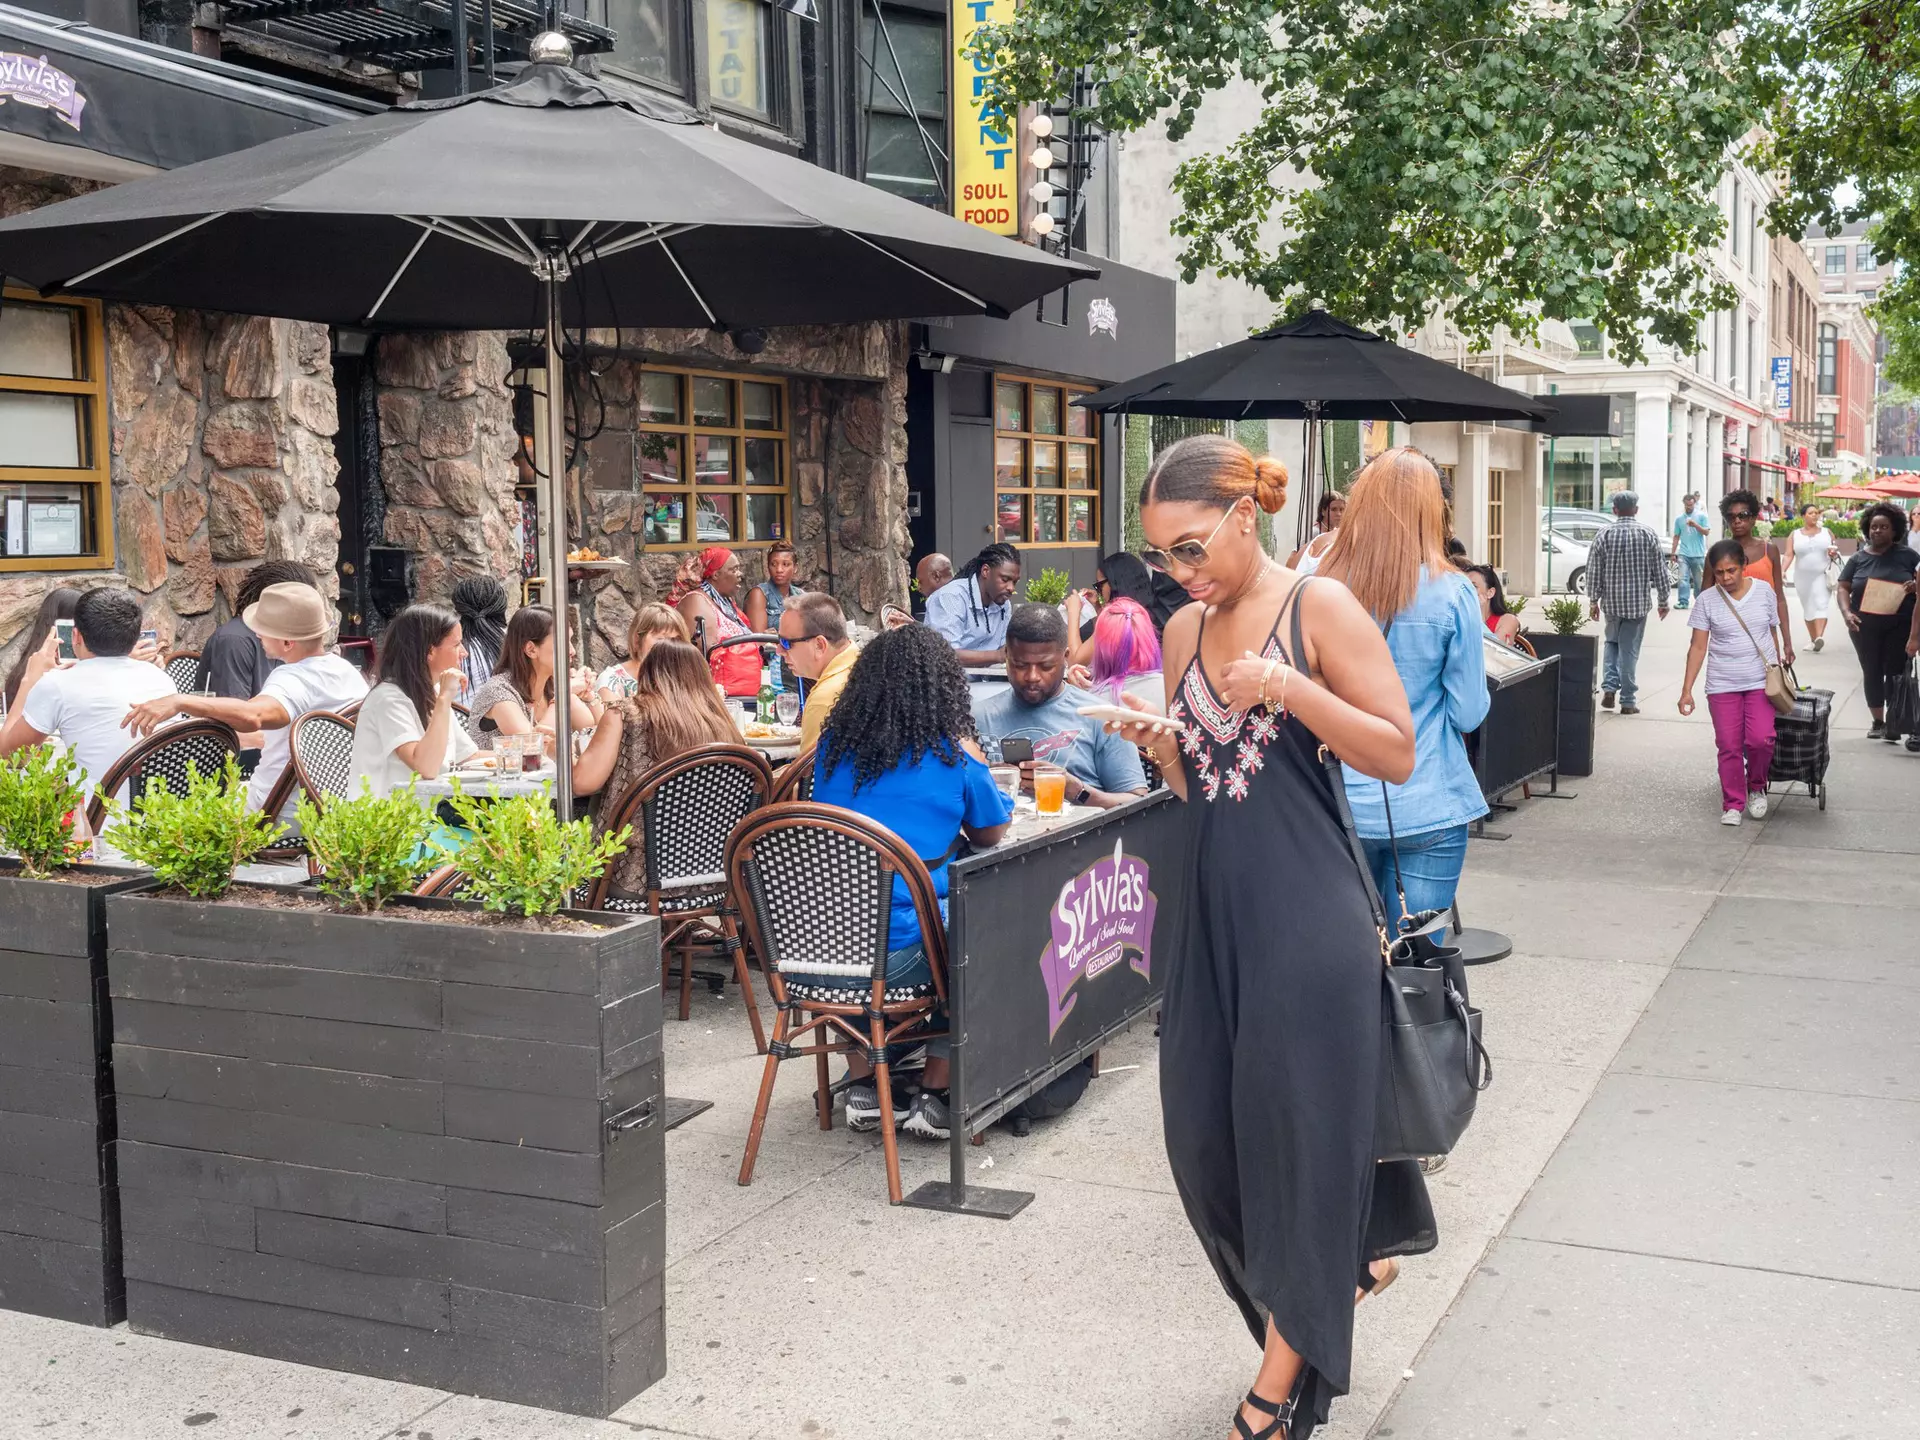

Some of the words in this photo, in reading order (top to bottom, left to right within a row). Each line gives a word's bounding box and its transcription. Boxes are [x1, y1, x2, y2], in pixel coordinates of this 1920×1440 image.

[963, 183, 1008, 200] SOUL
[964, 208, 1010, 224] FOOD
[1777, 358, 1790, 385] SALE
[1777, 386, 1790, 407] FOR
[1058, 837, 1143, 959] Sylvia's
[1069, 942, 1091, 970] Queen
[1091, 927, 1101, 952] of
[1100, 920, 1117, 941] Soul
[1117, 917, 1136, 935] Food
